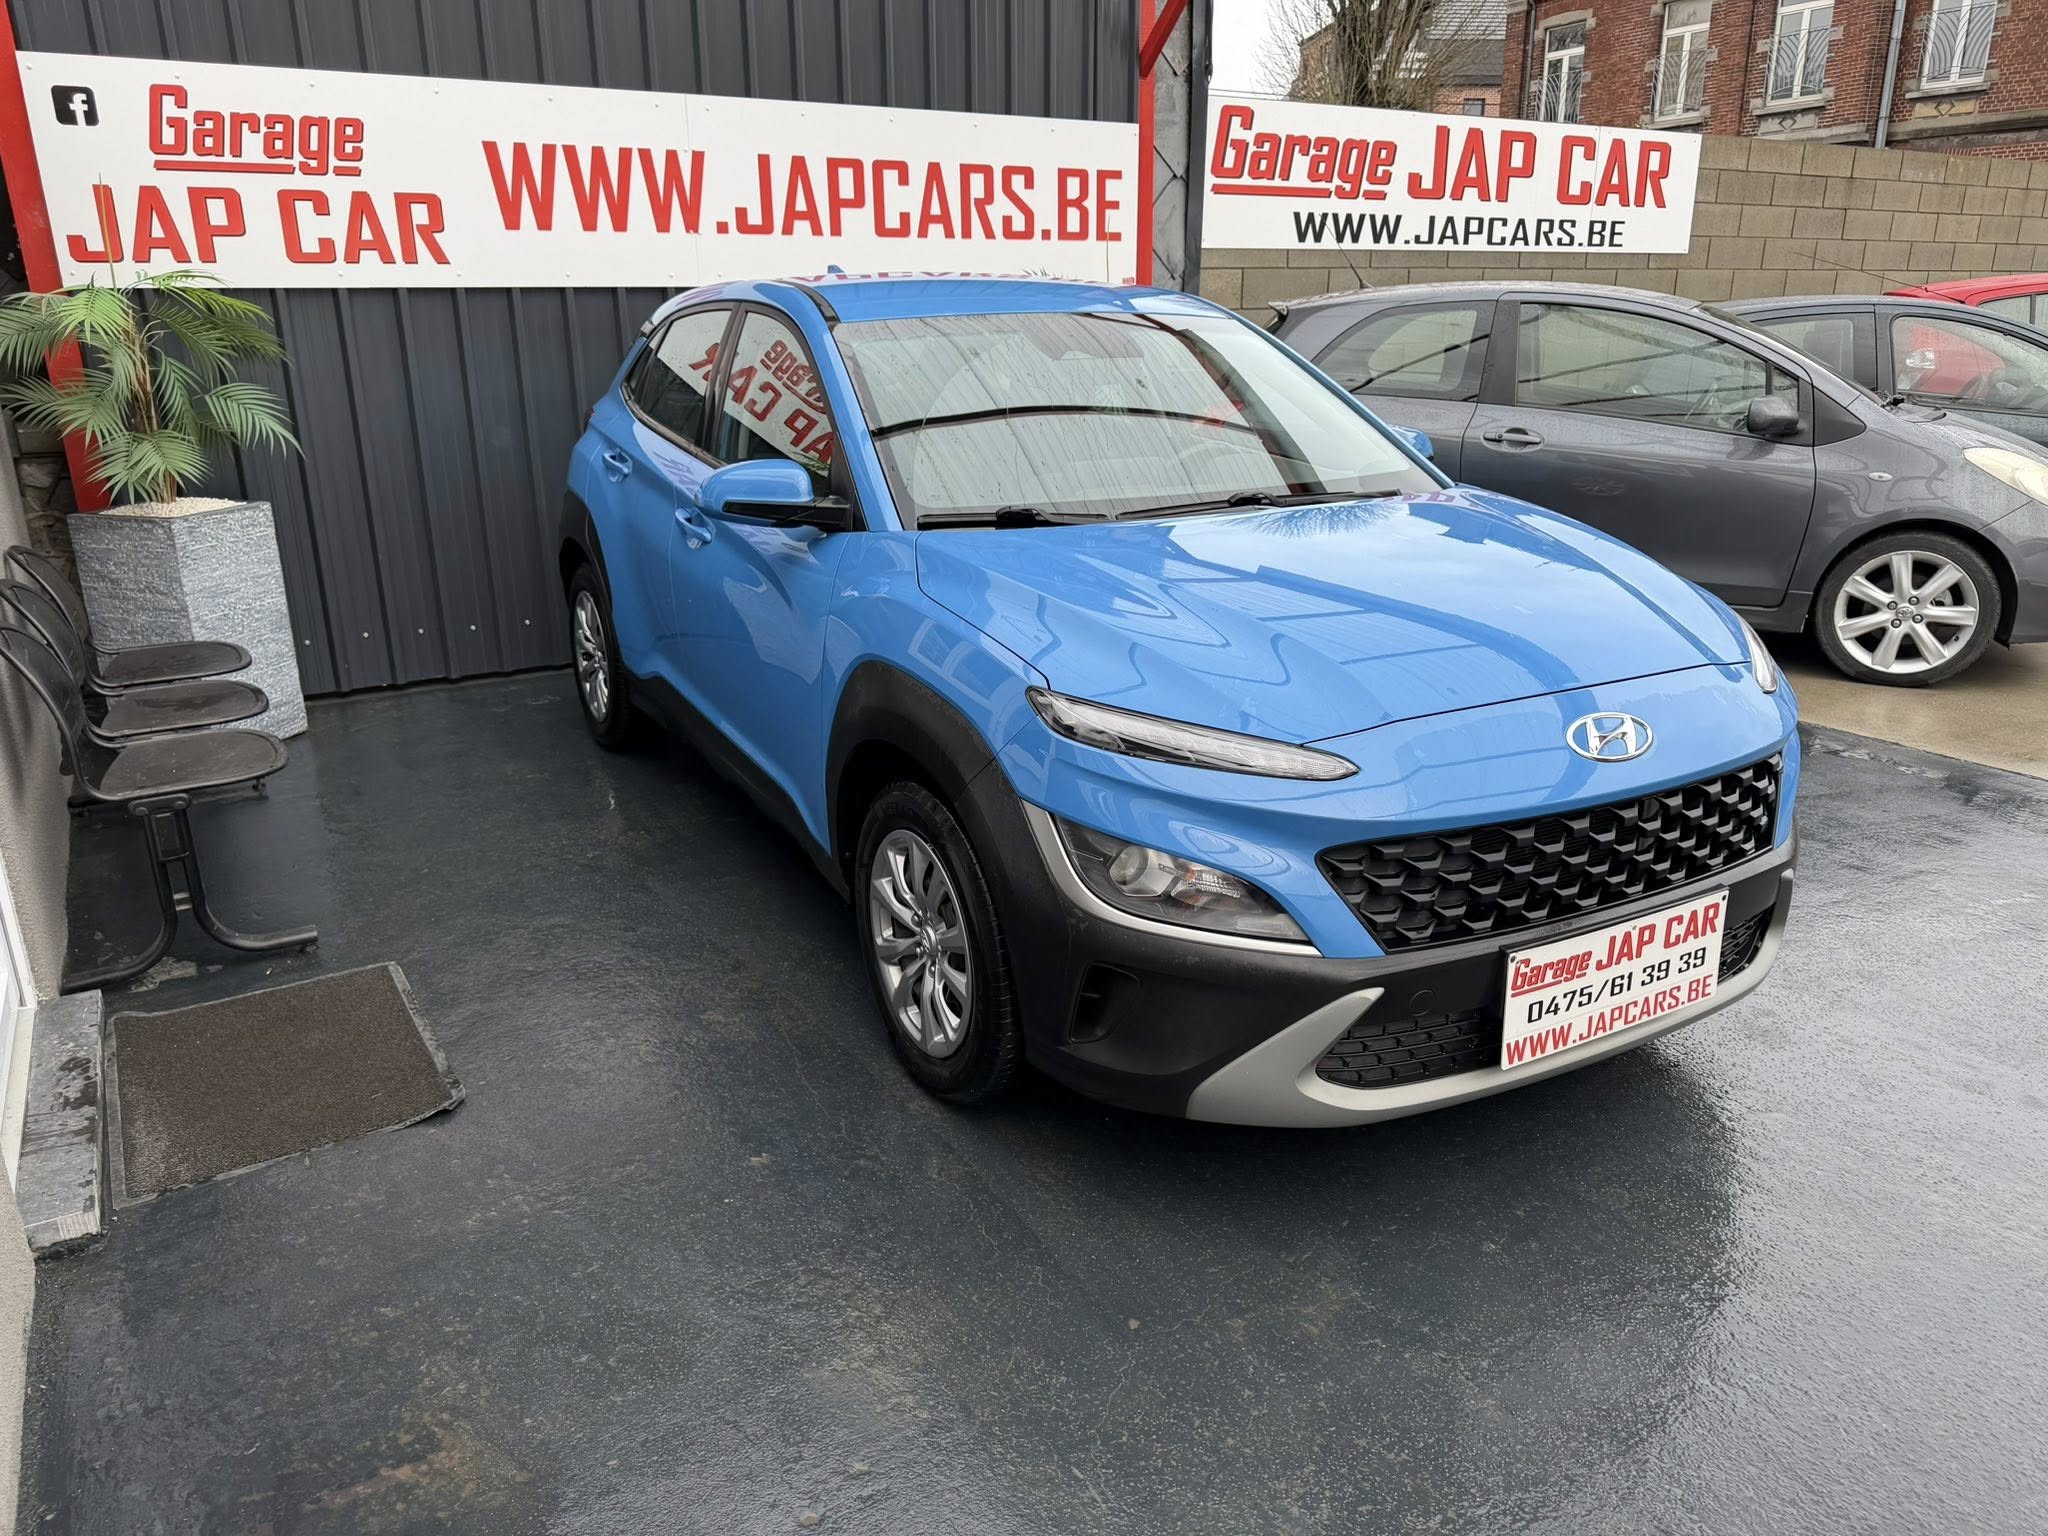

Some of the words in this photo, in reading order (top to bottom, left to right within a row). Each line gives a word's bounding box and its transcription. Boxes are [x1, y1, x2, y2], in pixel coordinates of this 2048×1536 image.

[149, 84, 364, 176] Garage
[1211, 105, 1397, 200] Garage
[1407, 125, 1537, 202] JAP
[1556, 135, 1672, 209] CAR
[67, 184, 245, 264] JAP
[276, 188, 450, 265] CAR
[482, 140, 1124, 243] WWW.JAPCARS.BE
[1293, 211, 1626, 248] WWW.JAPCARS.BE
[1510, 950, 1593, 998] Garage
[1595, 923, 1657, 972] JAP
[1663, 902, 1721, 950] CAR
[1527, 971, 1633, 1024] 0475/61
[1640, 959, 1671, 987] 39
[1678, 947, 1707, 975] 39
[1506, 974, 1713, 1066] WWW.JAPCARS.BE
